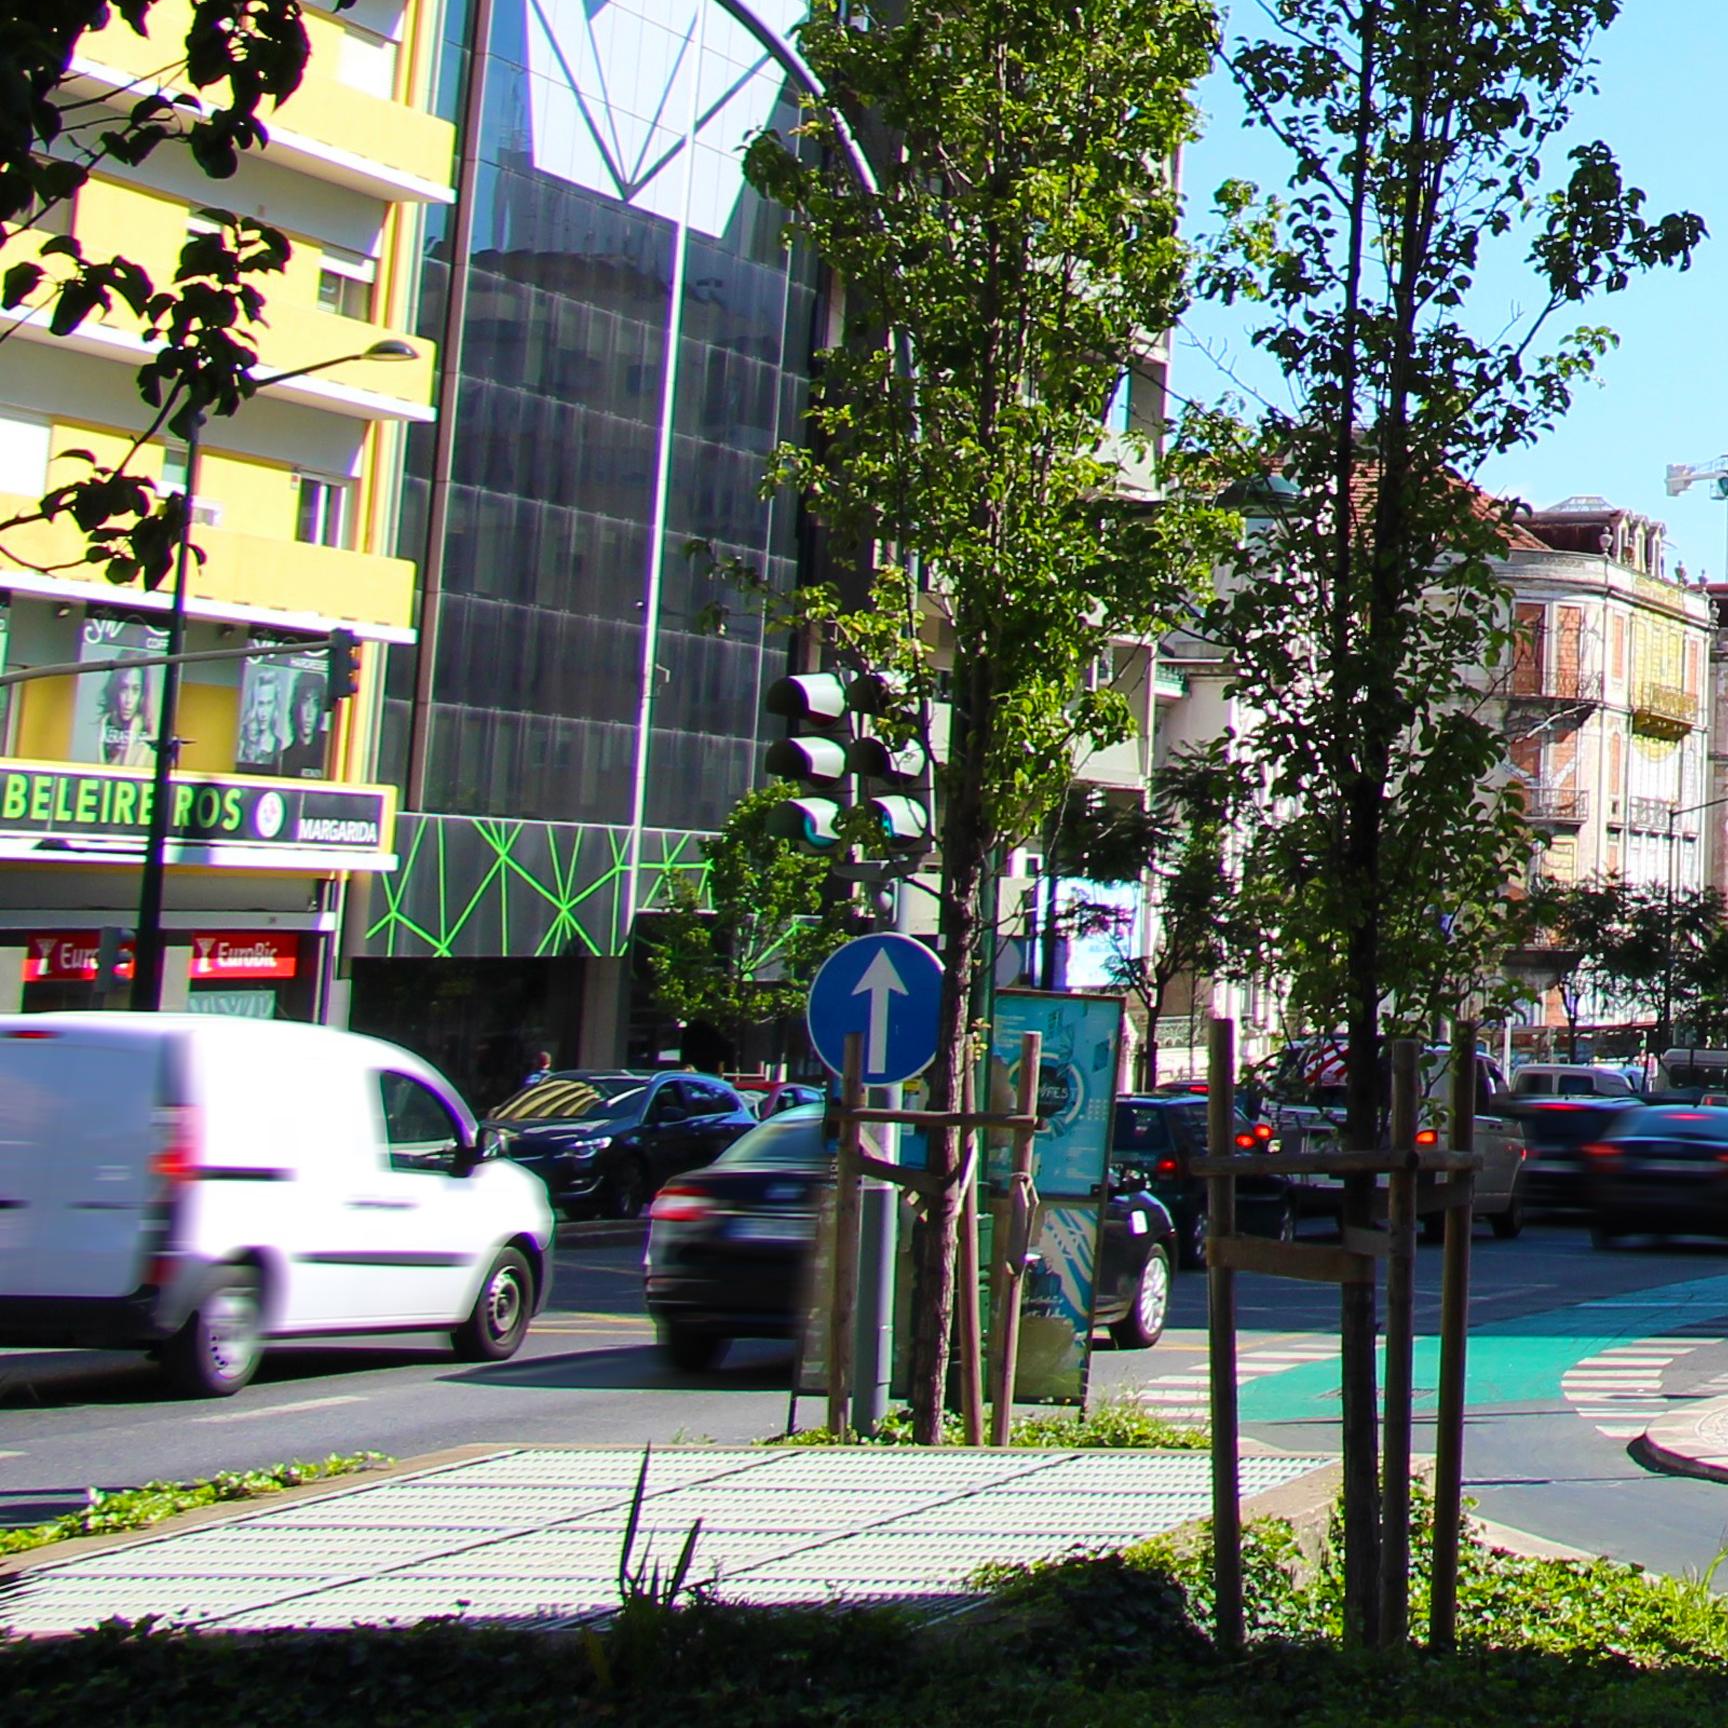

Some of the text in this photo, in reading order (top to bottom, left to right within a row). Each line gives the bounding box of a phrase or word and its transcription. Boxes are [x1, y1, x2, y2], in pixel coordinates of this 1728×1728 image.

[3, 773, 243, 832] BELEIREROS
[298, 818, 377, 843] MARGARIDA
[217, 941, 278, 969] EuroBic
